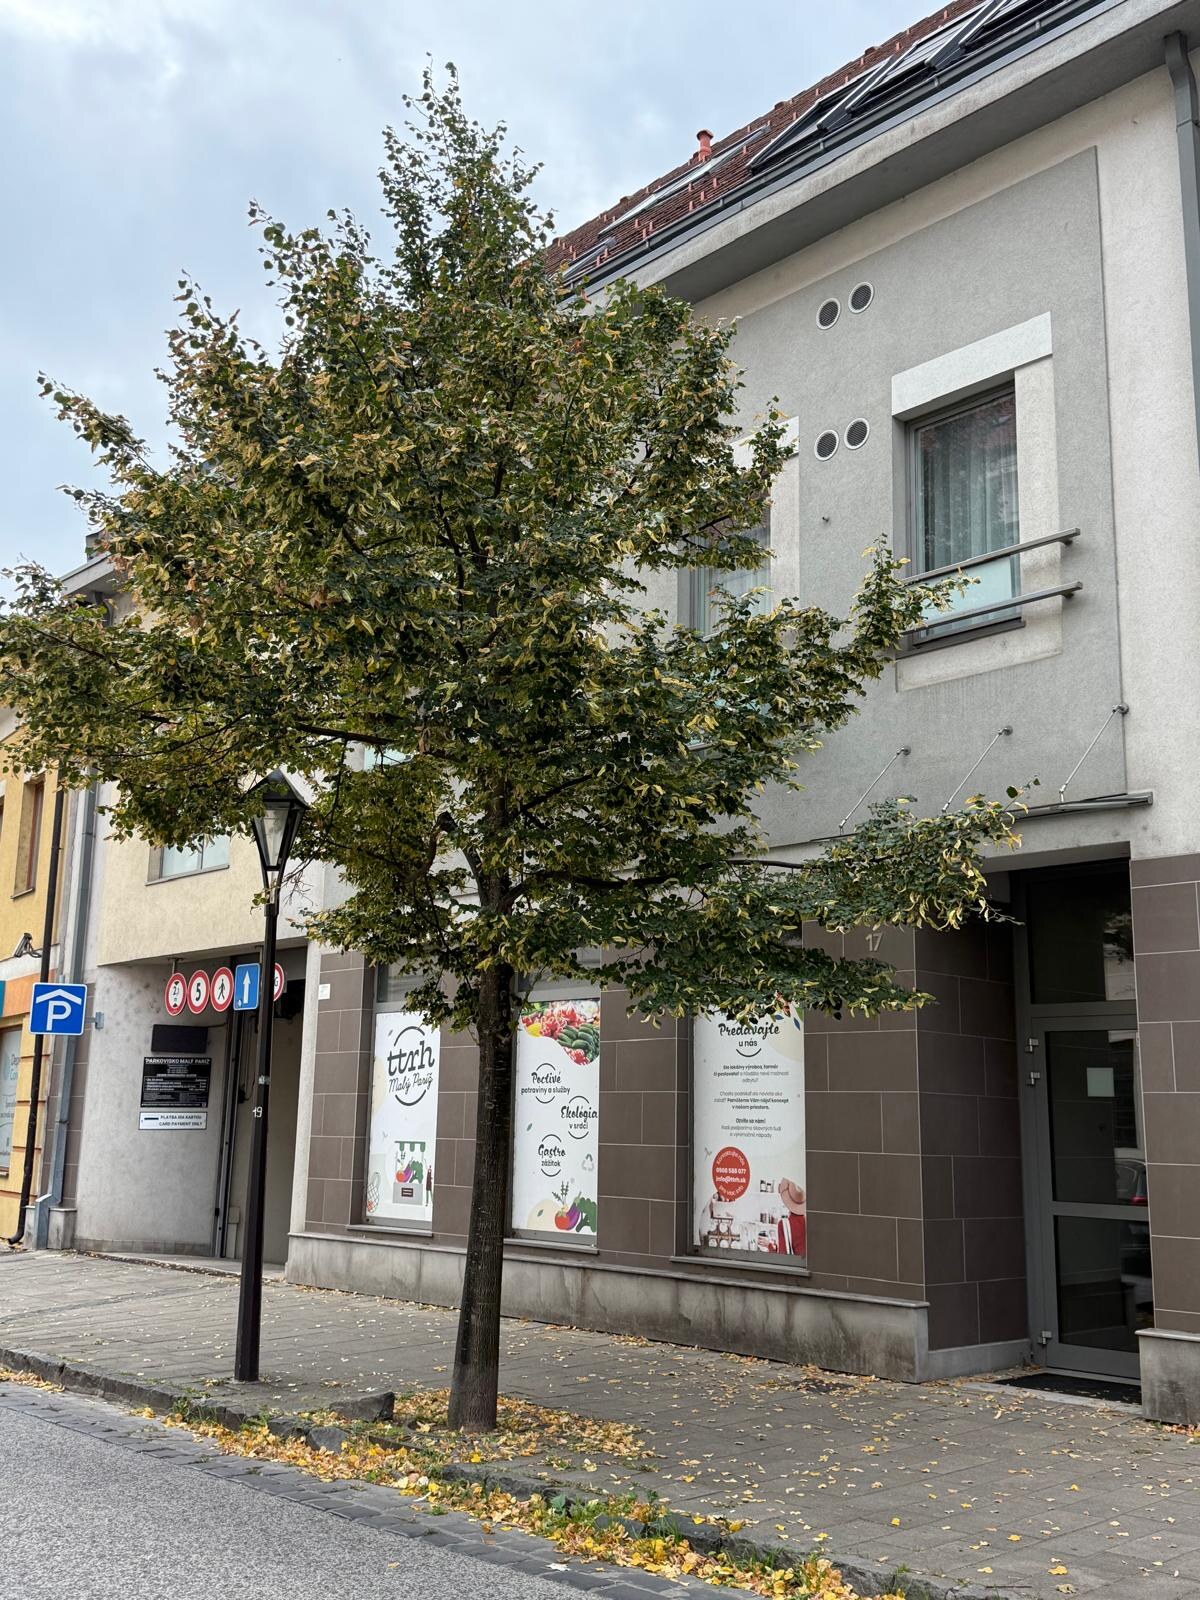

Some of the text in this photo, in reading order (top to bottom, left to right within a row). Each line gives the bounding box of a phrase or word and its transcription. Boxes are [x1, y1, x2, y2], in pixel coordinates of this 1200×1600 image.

[866, 932, 882, 952] 17
[196, 982, 201, 1001] 5
[46, 1000, 72, 1031] P
[744, 1038, 758, 1046] nás
[389, 1076, 411, 1095] Malý
[532, 1072, 561, 1084] Poctivé
[521, 1086, 547, 1095] potraviny
[552, 1086, 570, 1095] služby
[252, 1106, 262, 1118] 19
[561, 1106, 598, 1123] Ekológia
[538, 1144, 566, 1158] Gastro
